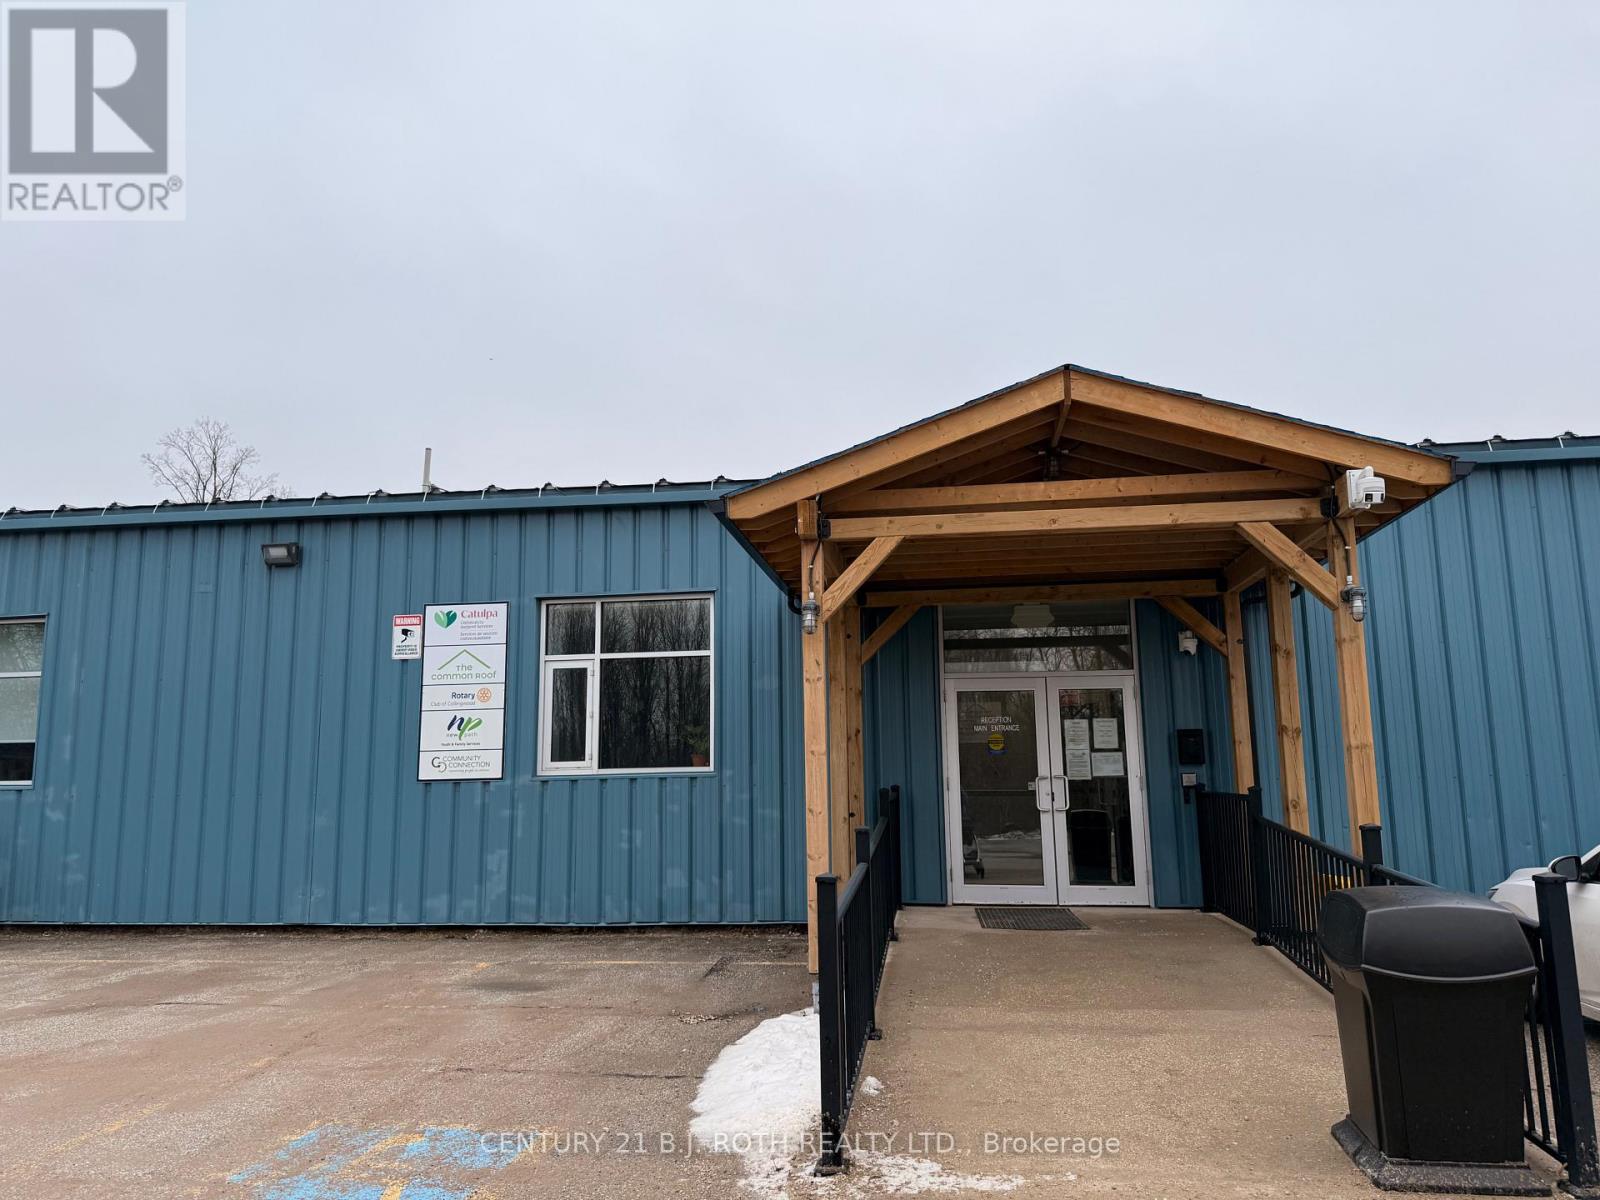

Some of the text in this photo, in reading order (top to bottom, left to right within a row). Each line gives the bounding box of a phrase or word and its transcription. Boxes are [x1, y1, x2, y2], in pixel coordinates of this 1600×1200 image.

[461, 609, 498, 619] Catulpa
[395, 617, 420, 625] WARNING
[456, 663, 472, 671] The
[431, 671, 496, 680] common Roof
[451, 692, 476, 700] Rotary
